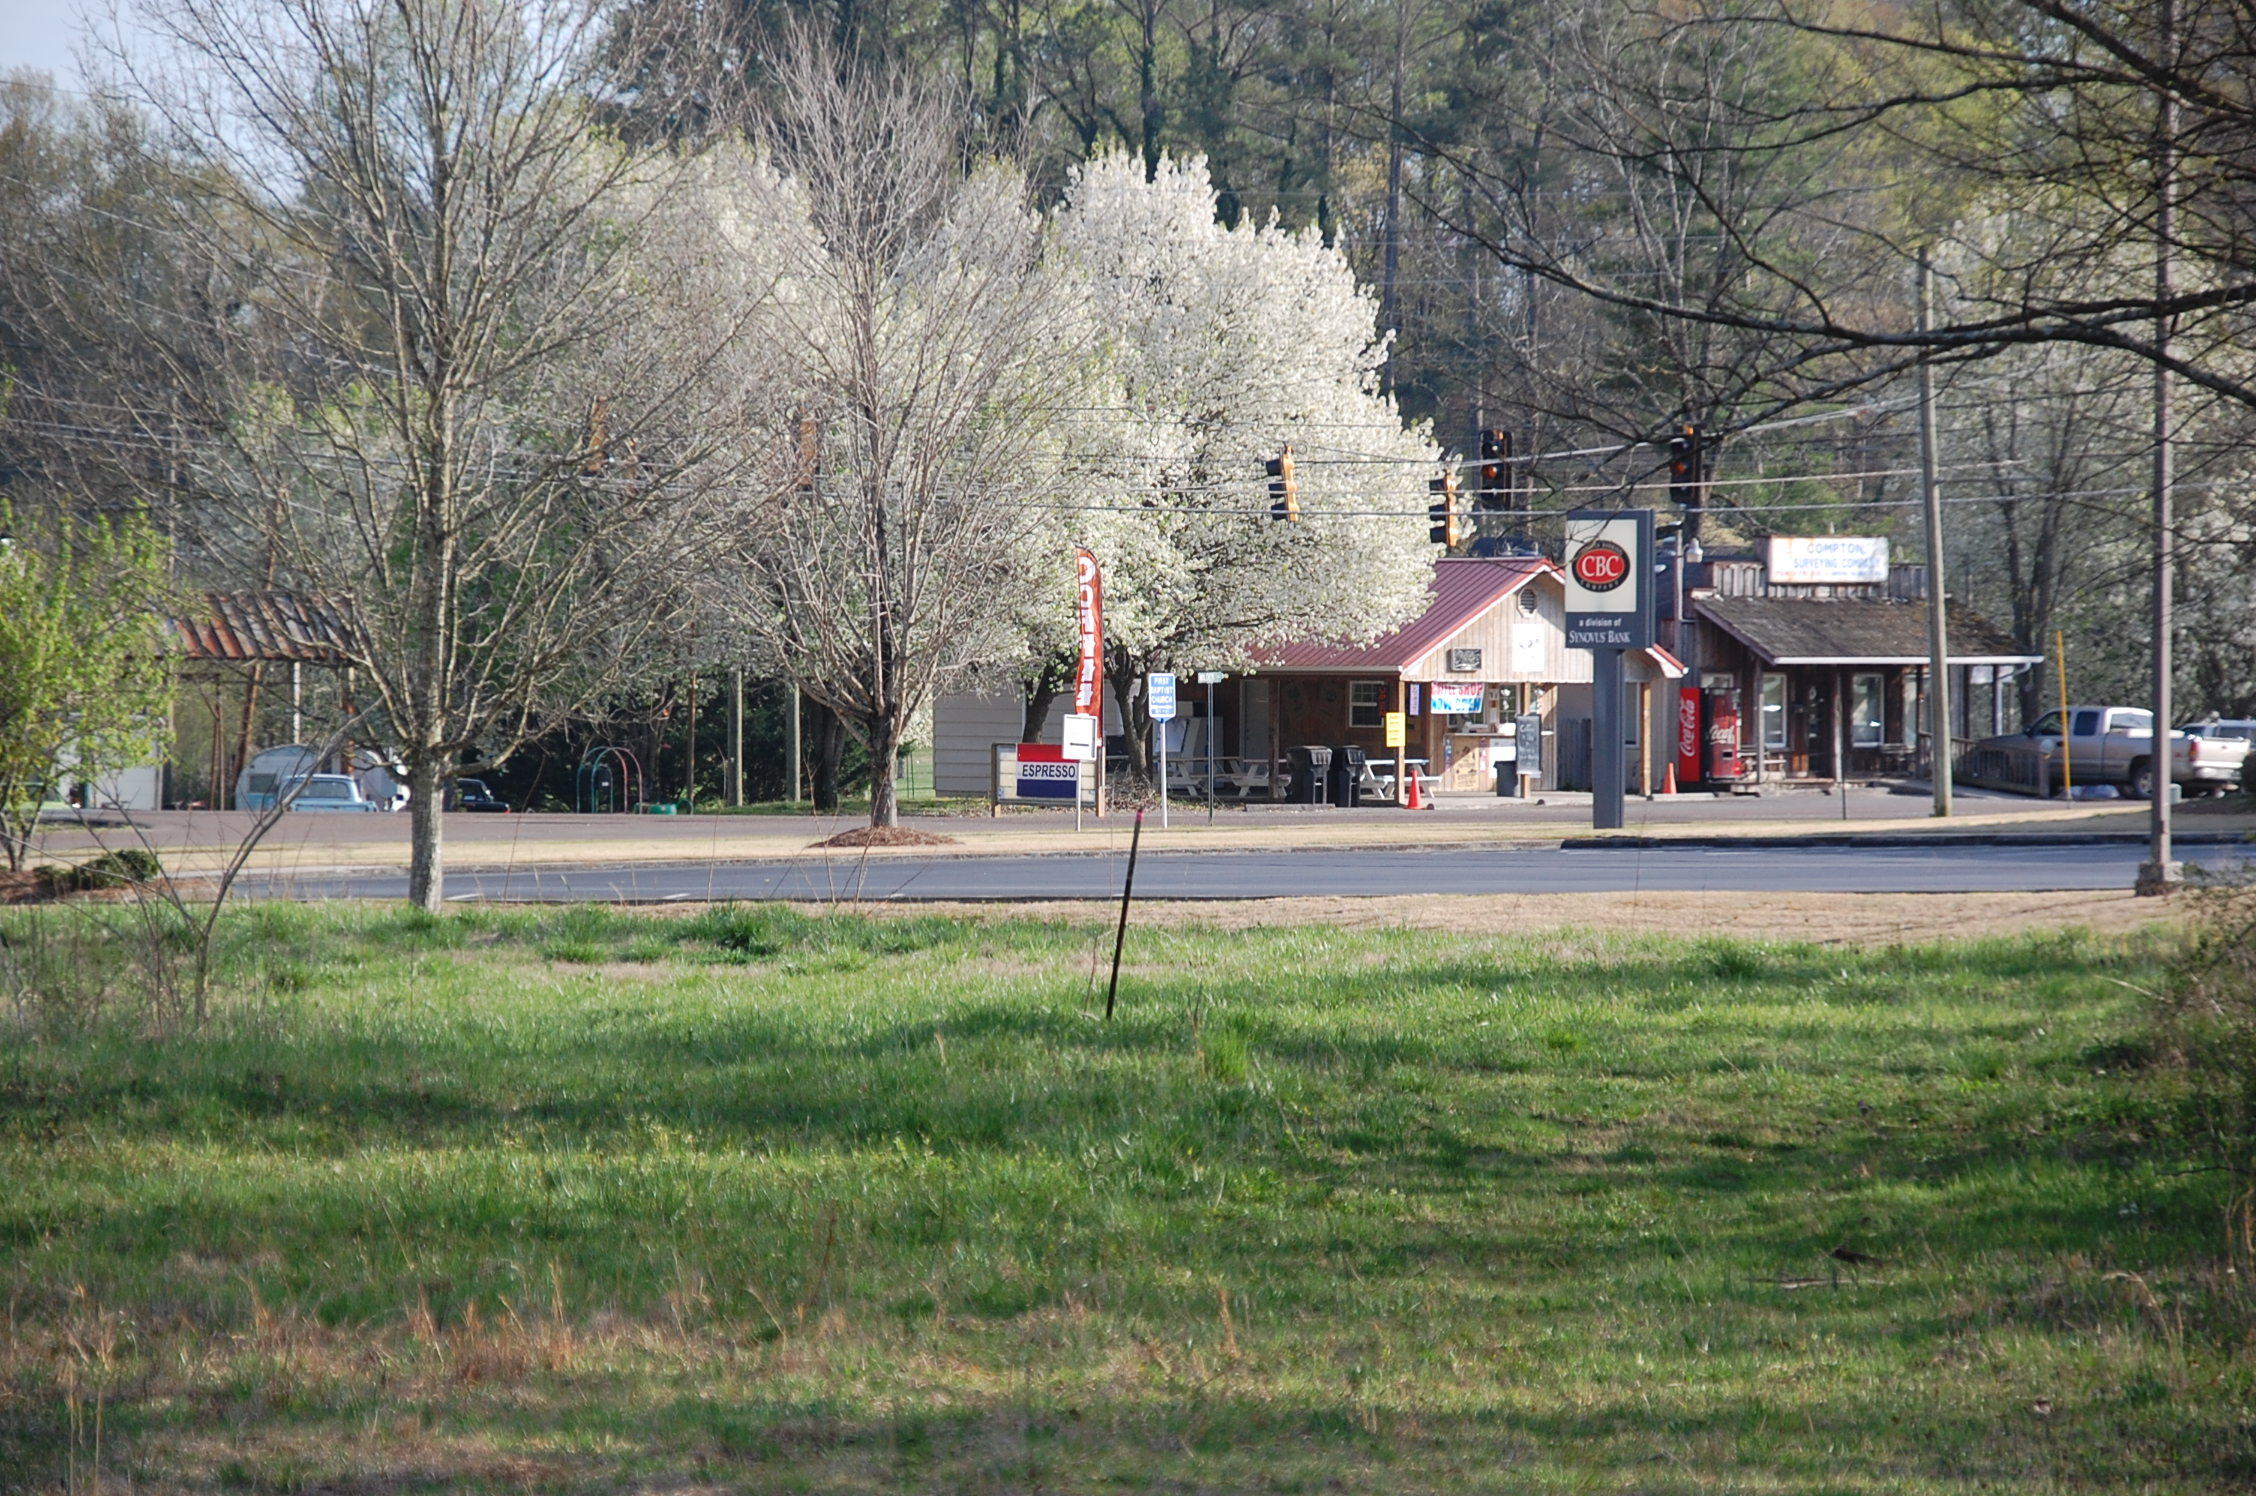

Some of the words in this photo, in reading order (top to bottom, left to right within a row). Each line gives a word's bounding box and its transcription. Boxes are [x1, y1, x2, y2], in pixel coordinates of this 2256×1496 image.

[1806, 543, 1865, 554] COMPTON
[1581, 555, 1619, 577] CBC
[1585, 617, 1612, 627] division
[1613, 618, 1622, 627] of
[1569, 630, 1606, 644] SYNOVUS
[1608, 630, 1631, 643] BANK
[1151, 695, 1173, 704] CHURCH
[1680, 697, 1696, 757] Coca-Cola
[1022, 764, 1076, 778] ESPRESSO
